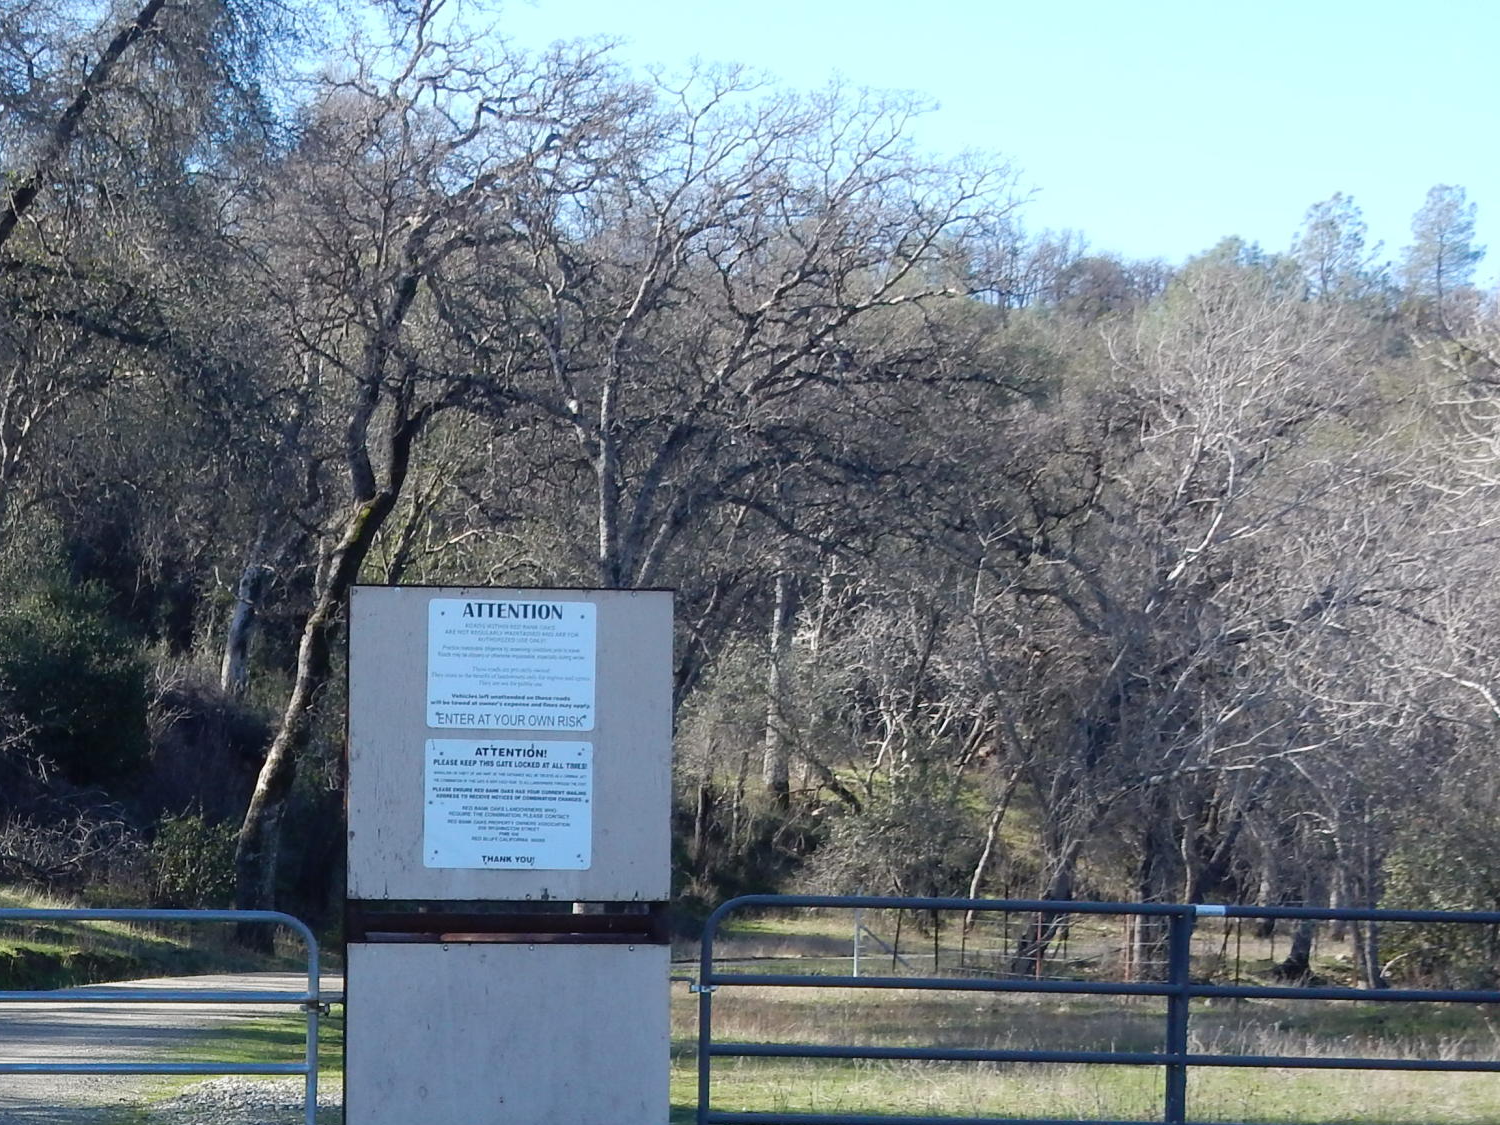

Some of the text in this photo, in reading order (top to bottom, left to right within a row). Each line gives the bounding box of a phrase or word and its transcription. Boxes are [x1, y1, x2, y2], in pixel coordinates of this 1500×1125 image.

[462, 602, 563, 620] ATTENTION
[438, 713, 584, 727] ENTER AT YOUR OWN RISK
[475, 747, 547, 758] ATTENTION!
[433, 758, 458, 766] PLEASE
[460, 759, 477, 767] KEEP
[496, 760, 512, 768] GATE
[482, 855, 512, 863] THANK
